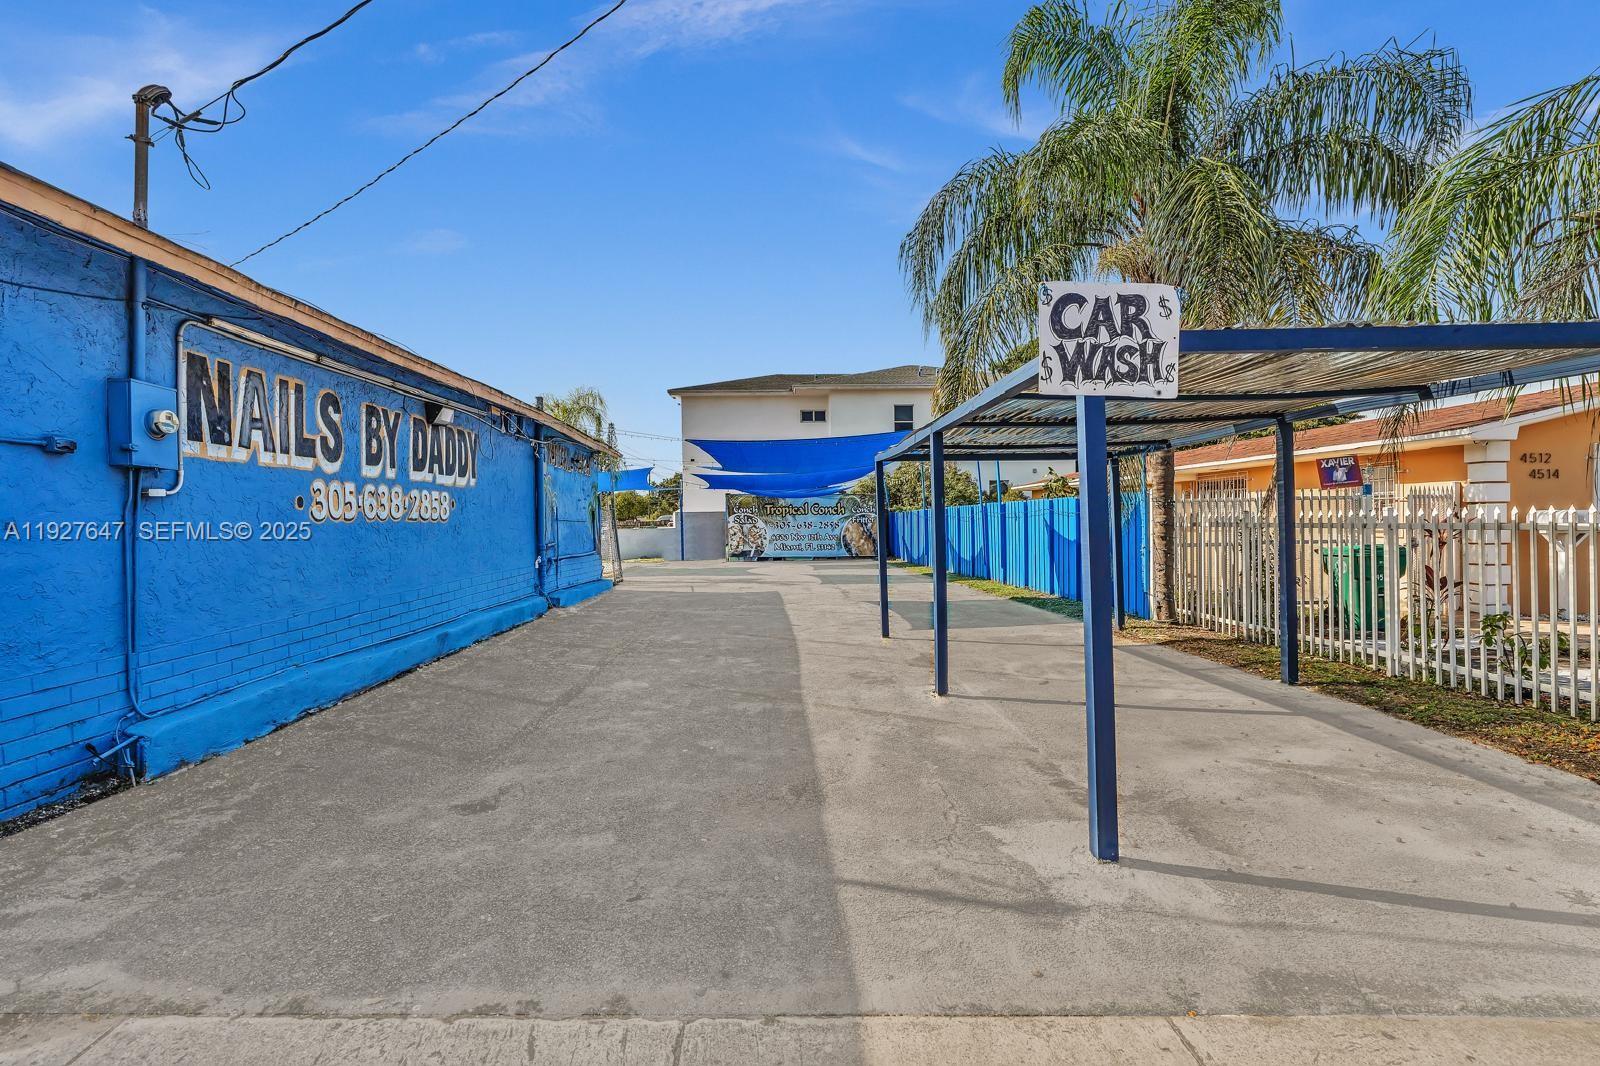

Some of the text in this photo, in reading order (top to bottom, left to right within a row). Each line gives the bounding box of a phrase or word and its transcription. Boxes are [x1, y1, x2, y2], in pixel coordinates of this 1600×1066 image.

[1050, 292, 1162, 342] CAR
[1051, 340, 1168, 390] WASH
[182, 350, 344, 474] NAILS
[361, 402, 401, 480] BY
[409, 415, 479, 487] DADDY
[1320, 457, 1355, 468] XAVIER
[1519, 453, 1551, 464] 4512
[1528, 469, 1560, 480] 4514
[733, 505, 758, 514] Conch
[765, 502, 845, 518] Tropical Conch
[851, 505, 876, 514] Conch
[733, 515, 759, 525] Salad
[774, 521, 841, 530] 305-638-2858
